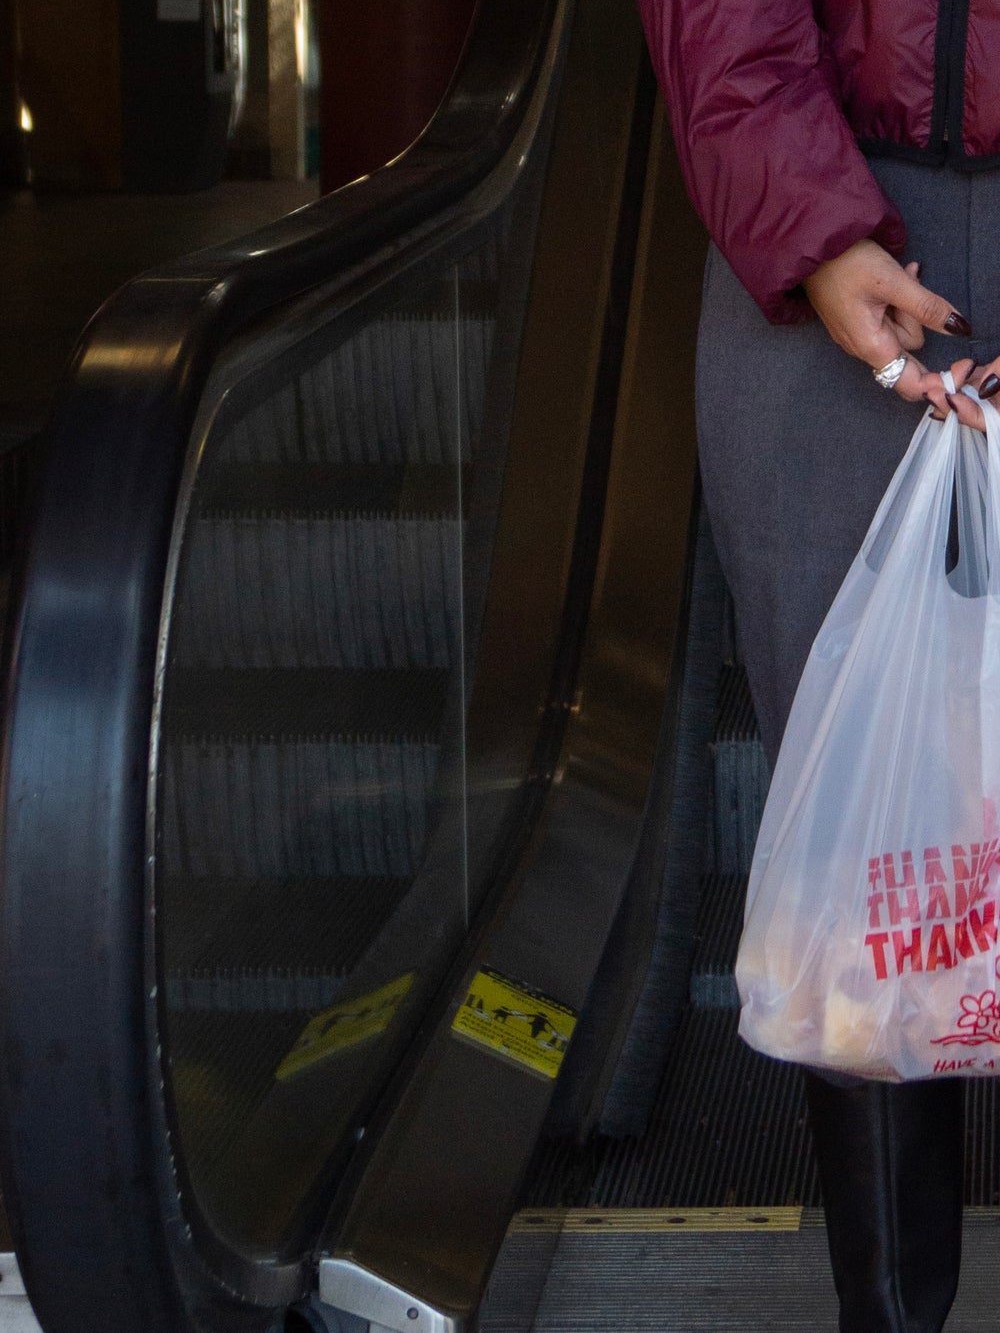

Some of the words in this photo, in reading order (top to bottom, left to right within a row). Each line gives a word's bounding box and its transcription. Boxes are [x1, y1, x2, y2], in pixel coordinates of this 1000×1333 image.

[867, 872, 988, 928] THAN
[864, 899, 998, 981] THANK
[933, 1057, 977, 1073] HAVE
